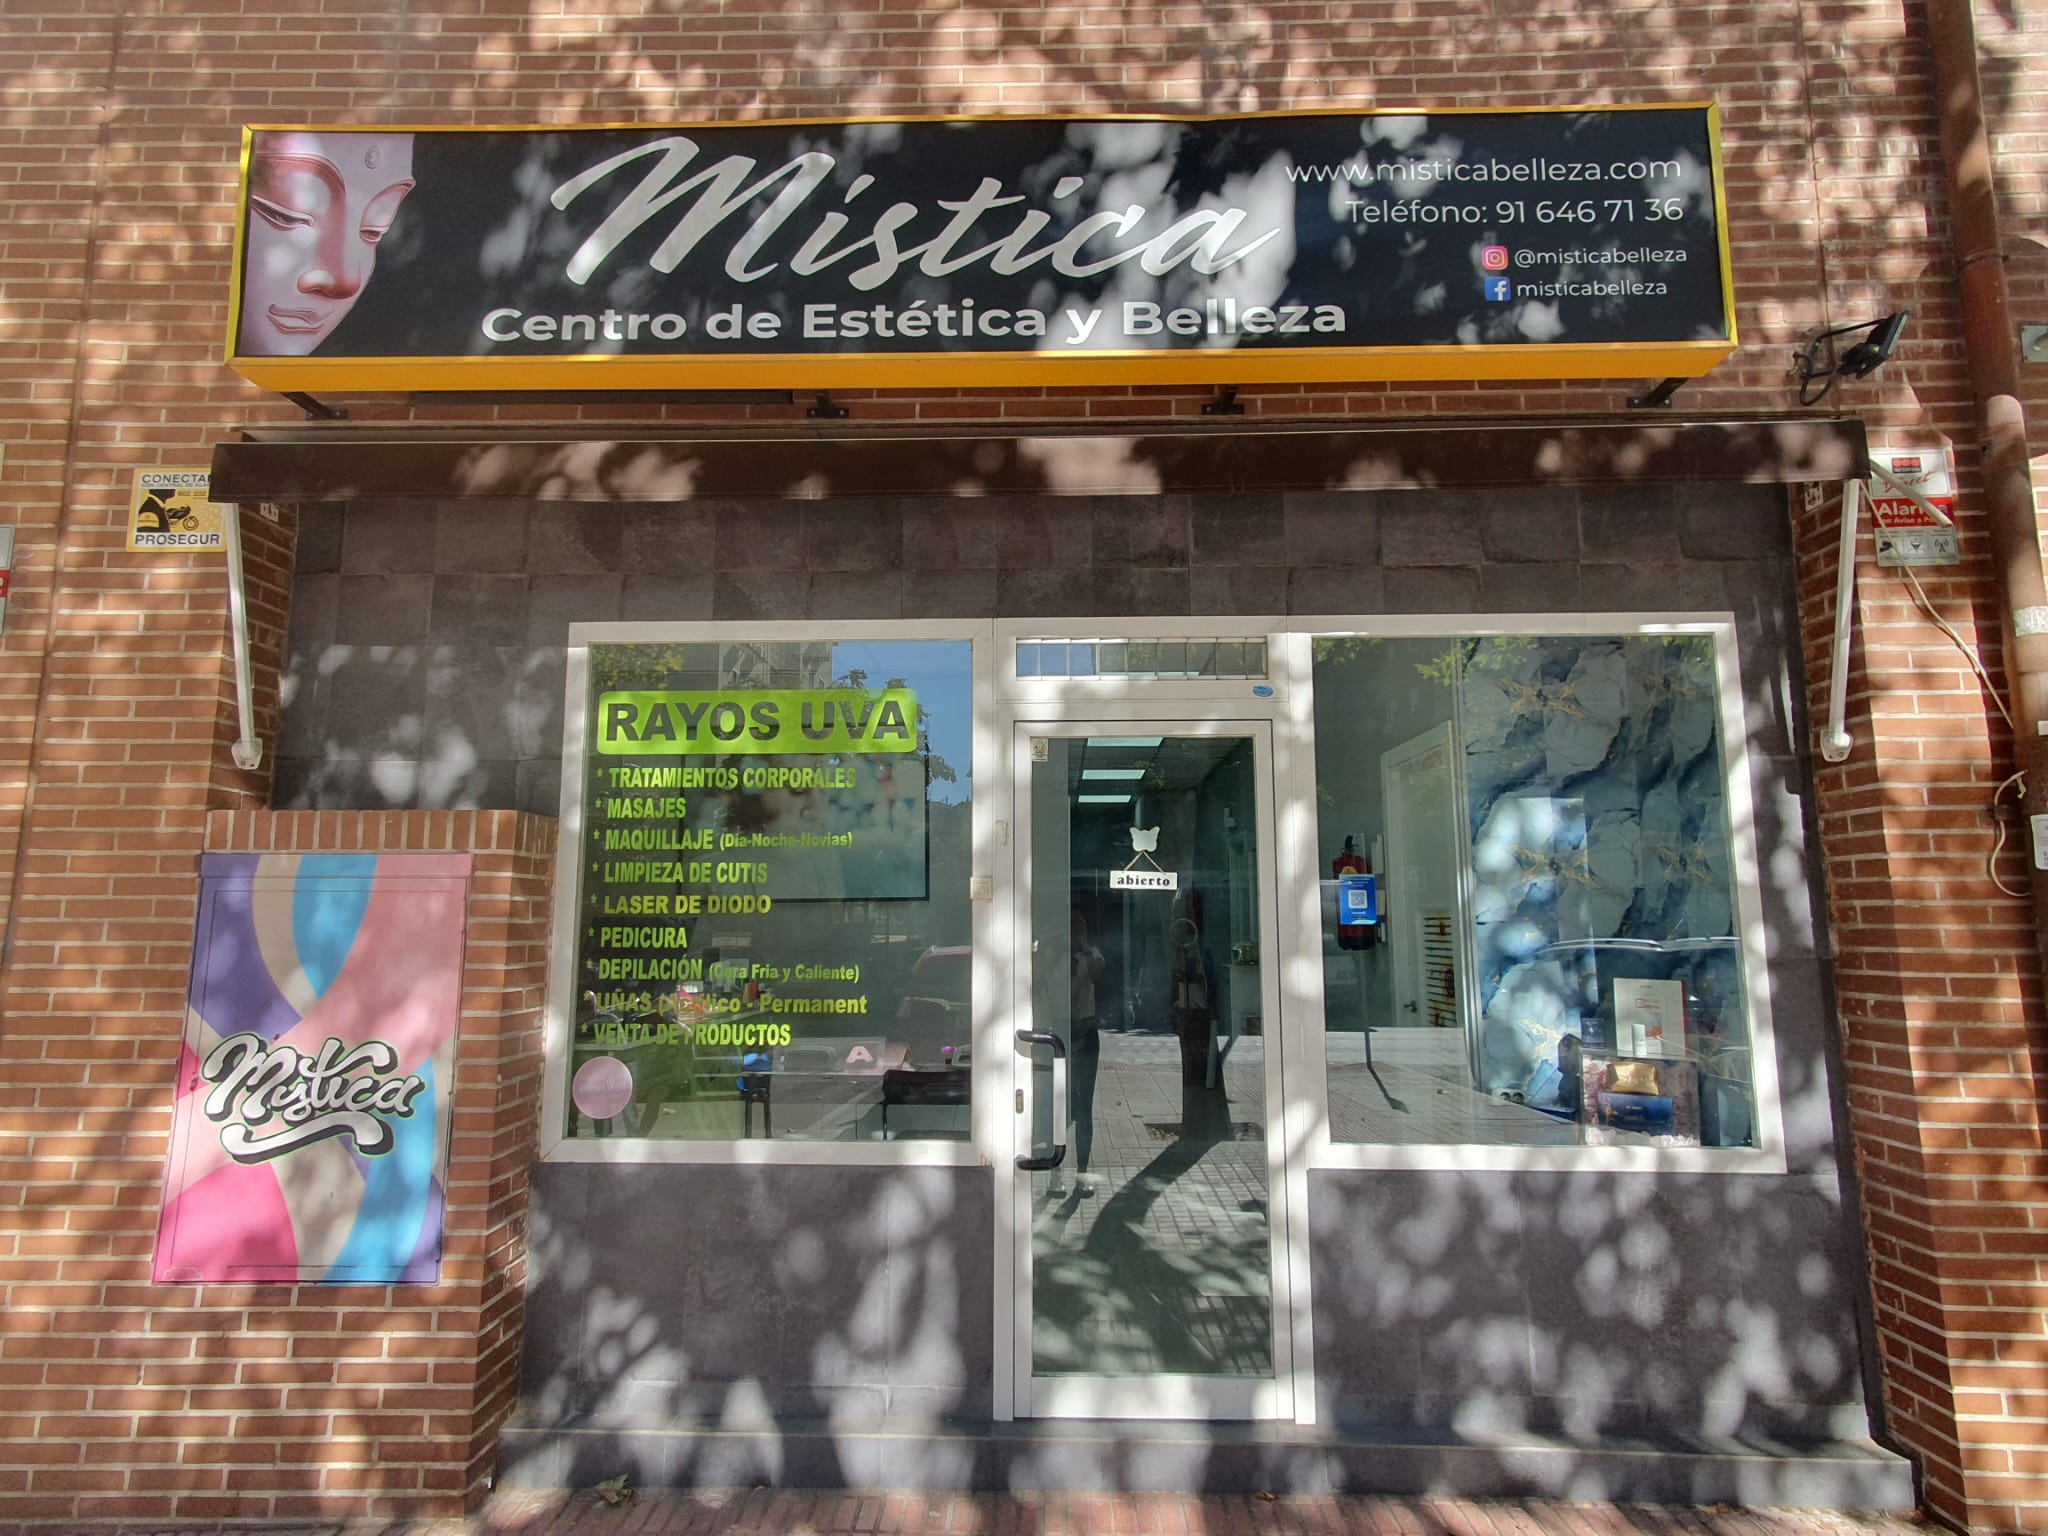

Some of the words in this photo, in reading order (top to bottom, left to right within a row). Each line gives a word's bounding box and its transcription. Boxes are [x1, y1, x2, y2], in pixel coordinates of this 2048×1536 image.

[1284, 157, 1682, 182] www.misticabelleza.com
[1346, 199, 1488, 224] Teléfono:
[1496, 200, 1526, 223] 91
[1536, 200, 1596, 223] 646
[1604, 199, 1635, 222] 71
[1644, 198, 1684, 222] 36
[1514, 246, 1688, 268] @misticabelleza
[1517, 278, 1668, 298] misticabelleza
[481, 307, 686, 343] Centro
[704, 303, 781, 340] de
[802, 300, 1047, 338] Estética
[1065, 309, 1103, 344] y
[1122, 297, 1346, 335] Belleza
[135, 534, 220, 545] PROSEGUR
[606, 702, 781, 742] RAYOS
[801, 700, 910, 740] UVA
[609, 767, 739, 788] TRATAMIENTOS
[743, 767, 857, 789] CORPORALES
[607, 798, 687, 819] MASAJES
[605, 829, 714, 850] MAQUILLAJE
[604, 862, 685, 883] LIMPIEZA
[689, 862, 712, 883] DE
[716, 862, 769, 883] CUTIS
[1117, 875, 1170, 887] abierto
[604, 895, 670, 914] LASER
[675, 895, 701, 914] DE
[708, 895, 772, 914] DIODO
[600, 927, 688, 948] PEDICURA
[599, 954, 703, 980] DEPILACIÓN
[782, 969, 791, 983] y
[794, 964, 860, 983] Caliente)
[759, 993, 867, 1013] Permanent
[595, 1024, 650, 1045] VENTA
[656, 1024, 679, 1044] DE
[685, 1024, 791, 1046] PRODUCTOS
